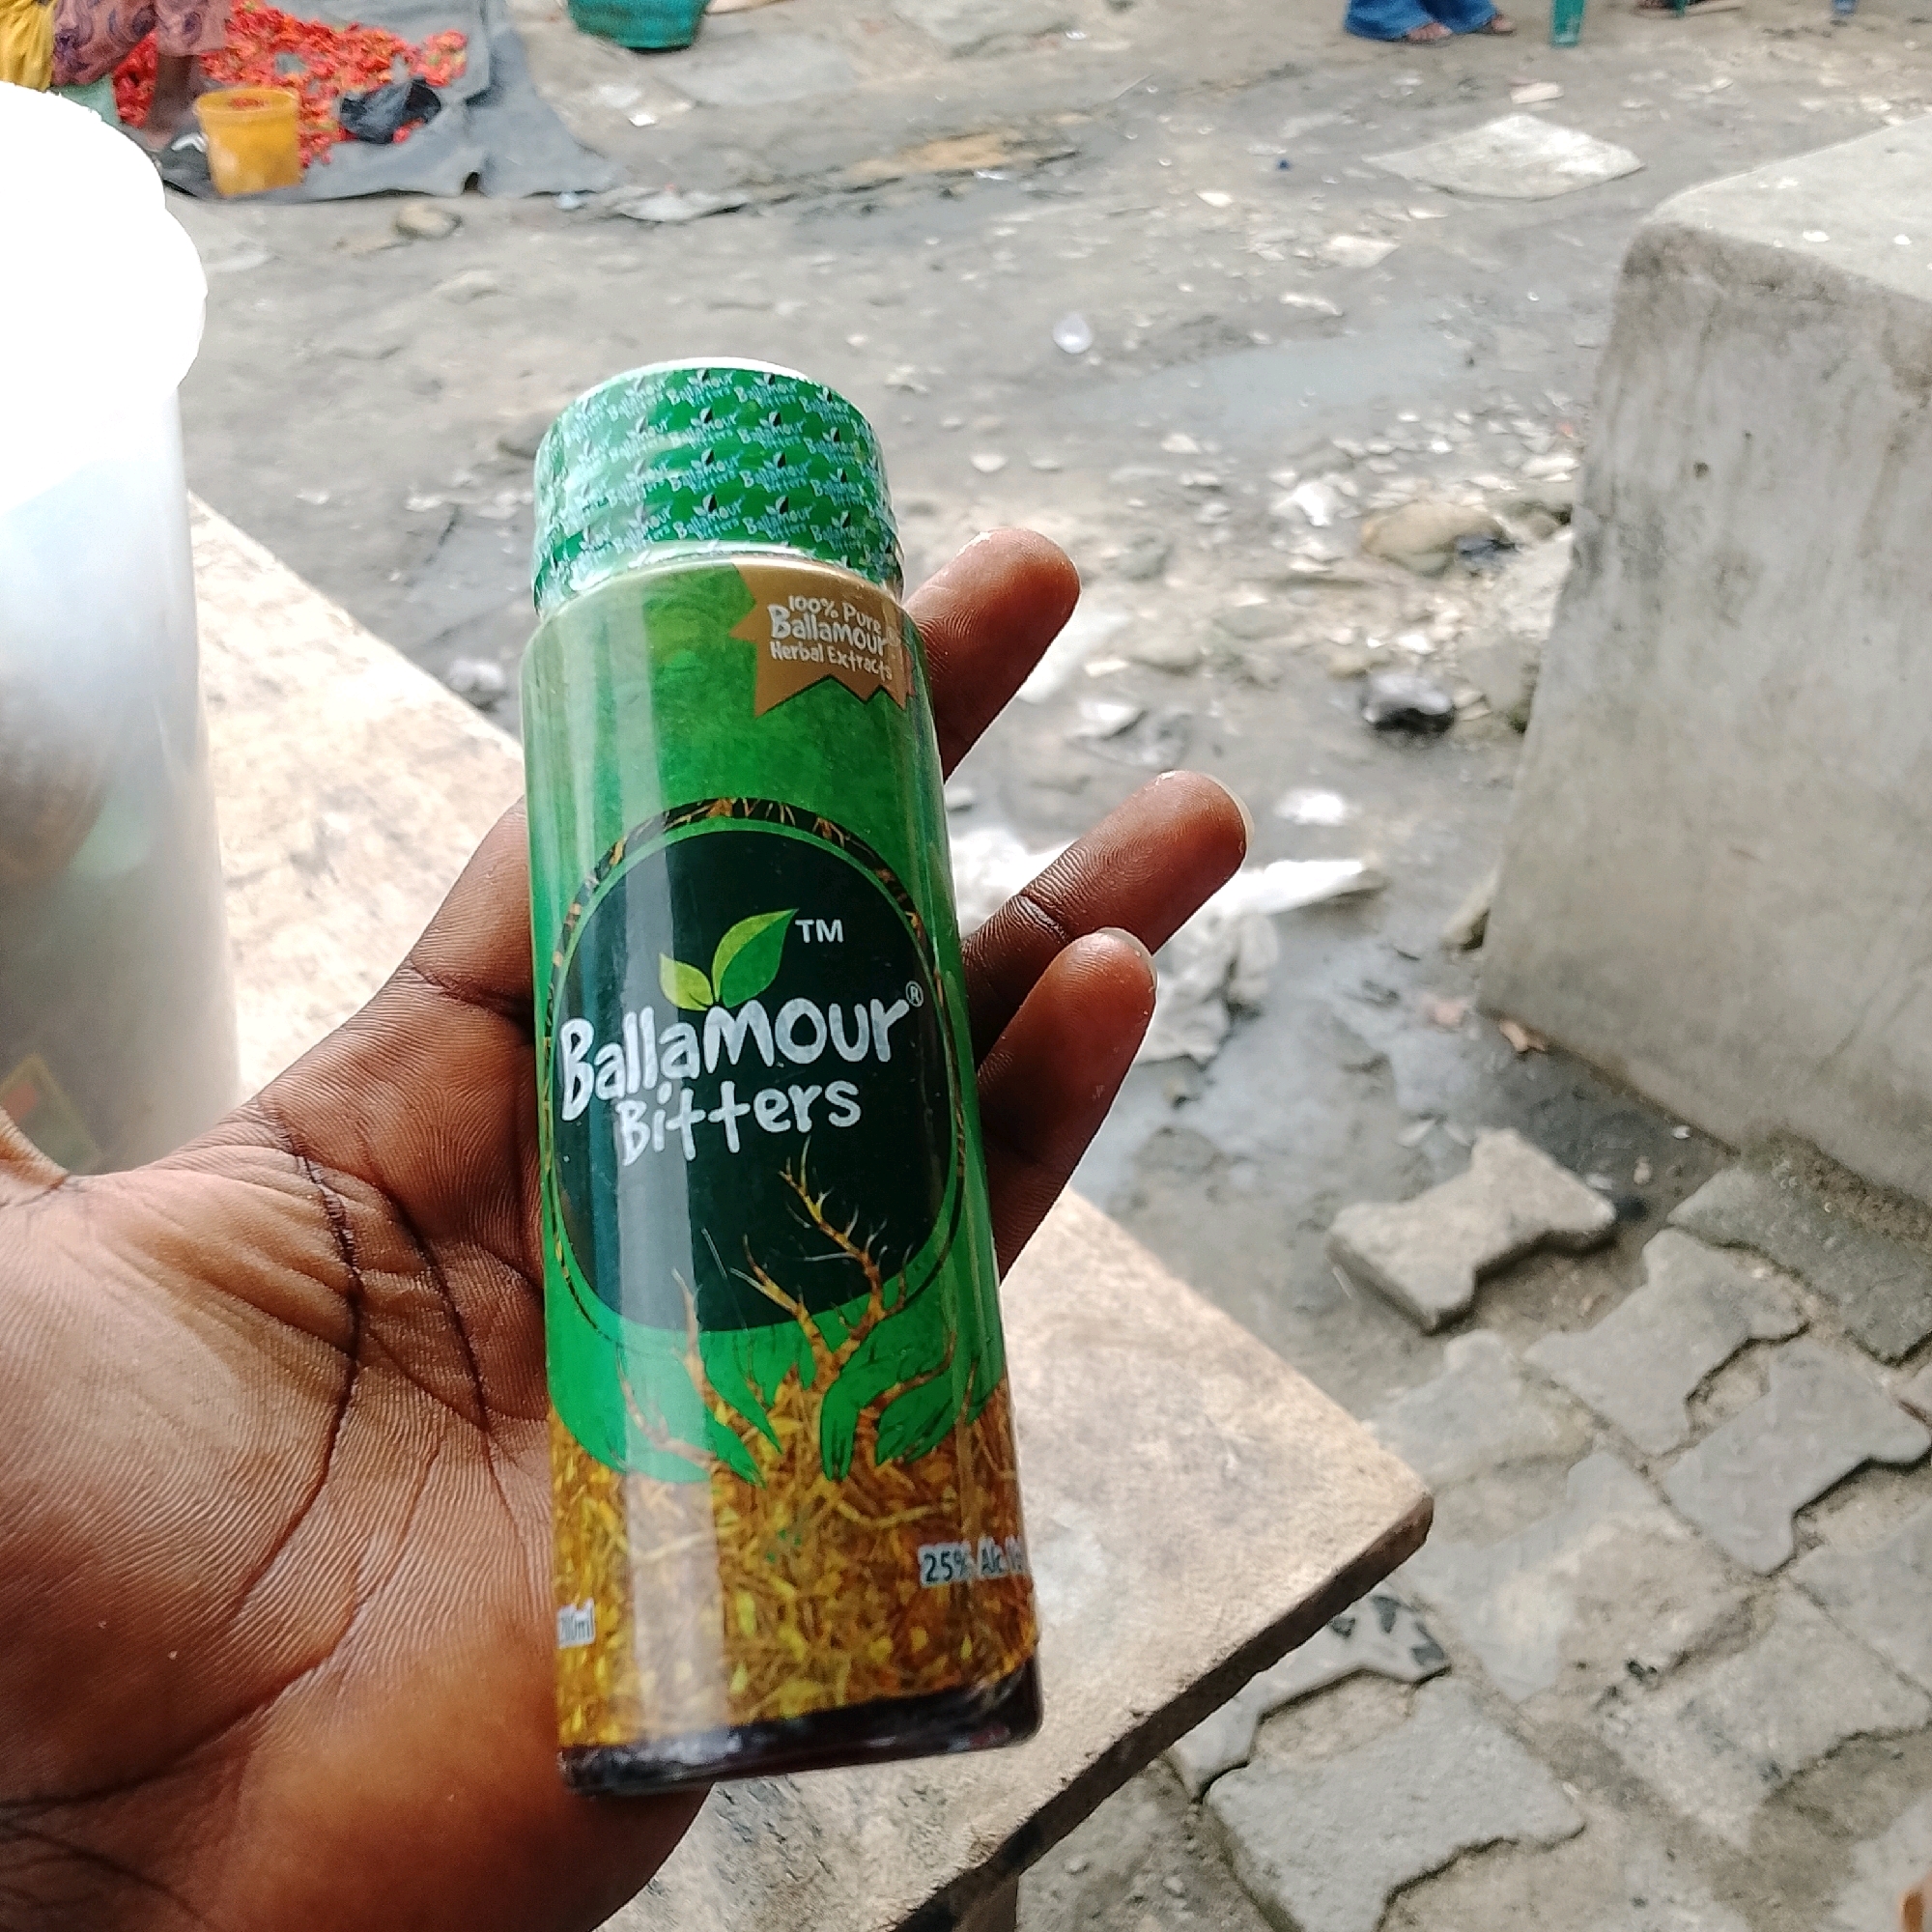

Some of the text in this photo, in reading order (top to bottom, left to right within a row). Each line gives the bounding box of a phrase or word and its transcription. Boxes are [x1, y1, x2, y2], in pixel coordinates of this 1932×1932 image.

[788, 595, 881, 637] 100% Pure
[770, 640, 893, 682] Herbal Extracts
[795, 919, 843, 943] TM
[615, 1079, 862, 1166] Bitters
